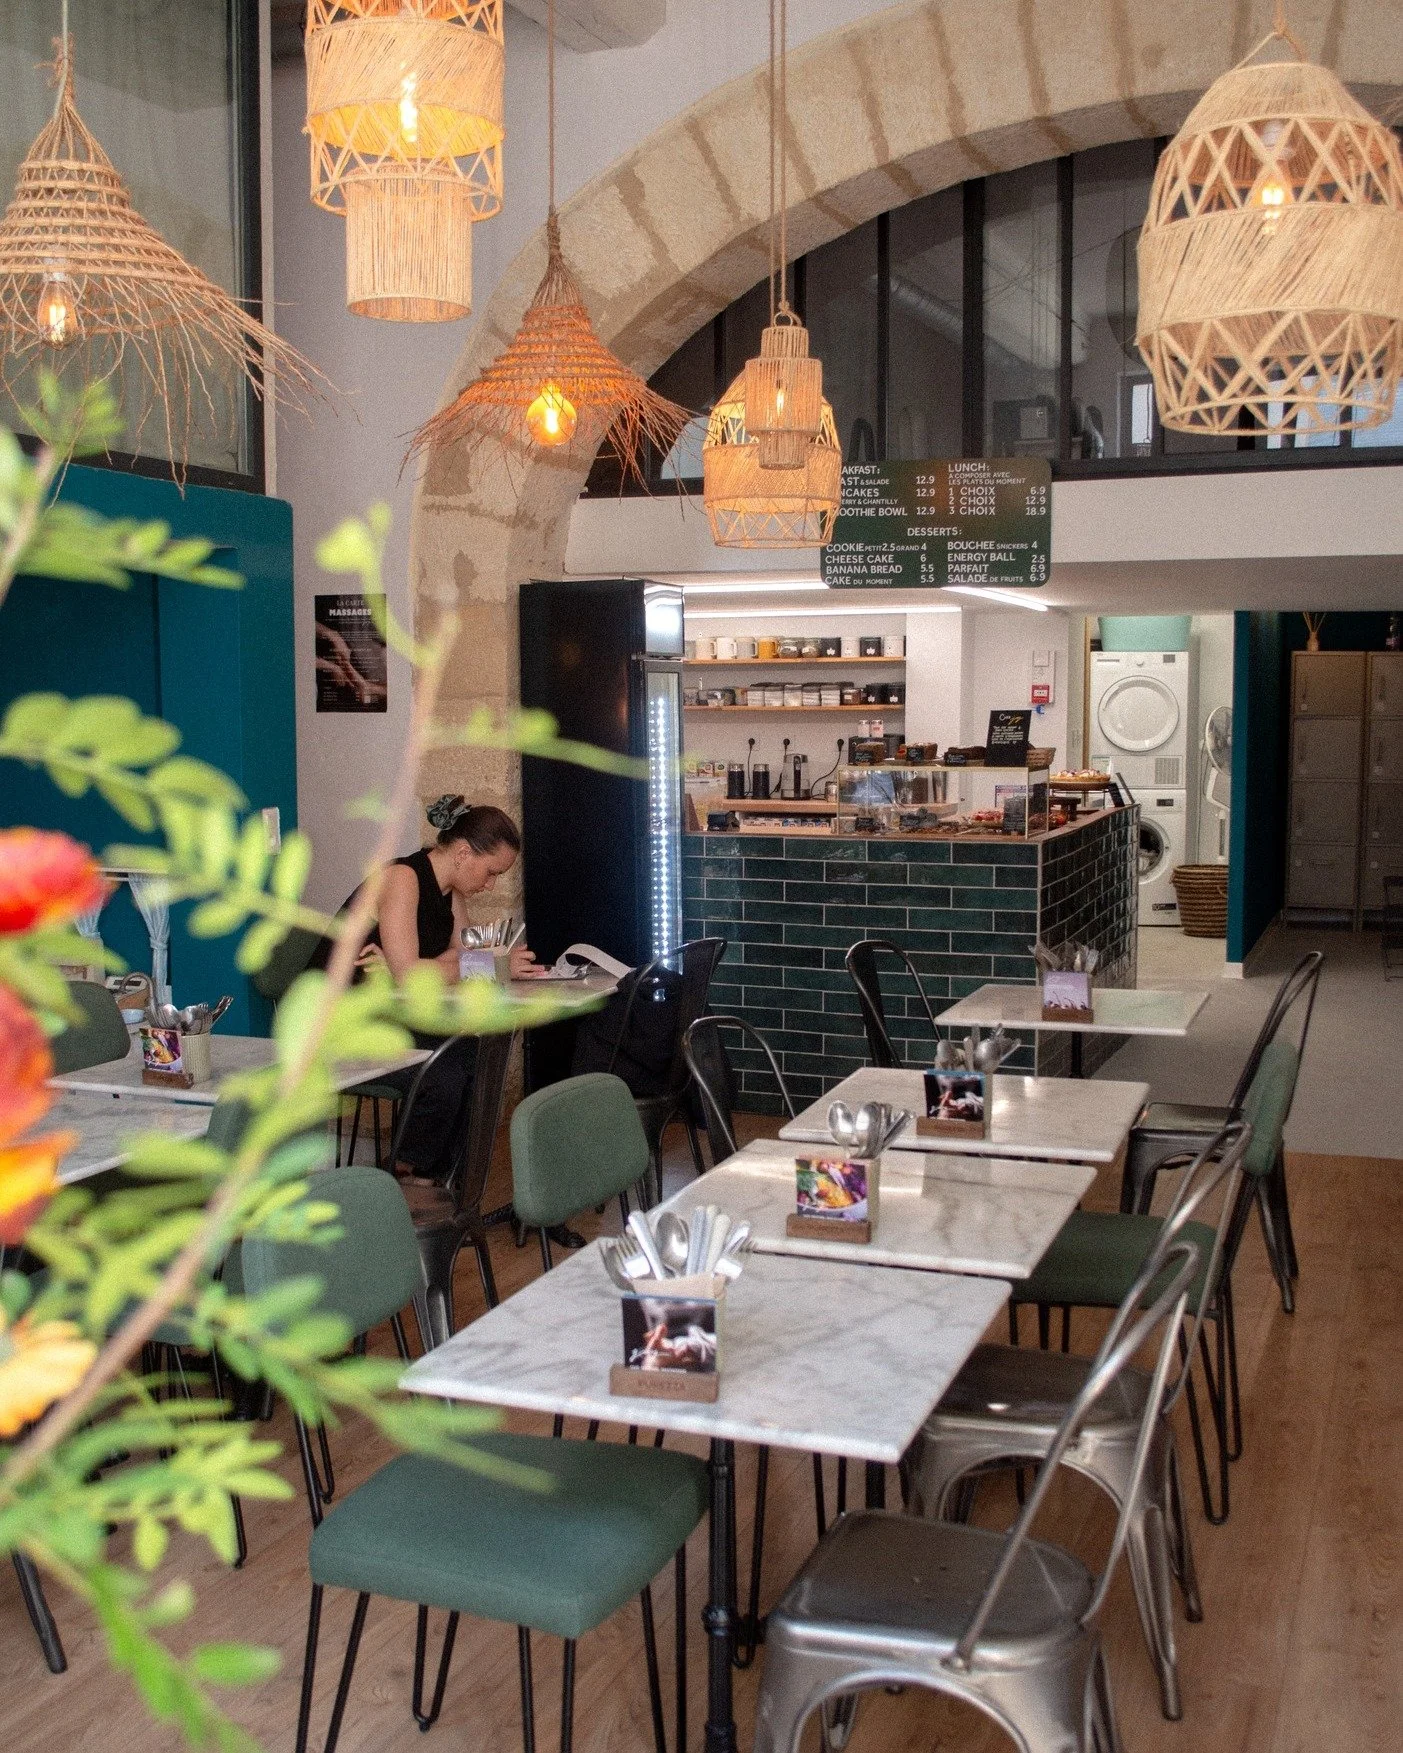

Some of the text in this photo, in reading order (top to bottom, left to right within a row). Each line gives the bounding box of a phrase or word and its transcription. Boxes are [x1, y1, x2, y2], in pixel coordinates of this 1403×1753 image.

[842, 466, 880, 474] AKFAST:
[948, 463, 990, 472] LUNCH:
[841, 477, 859, 485] AST
[916, 476, 935, 484] 12.9
[841, 489, 935, 497] NCAKES 12.9
[960, 487, 995, 495] CHOIX
[1030, 486, 1046, 495] 6.9
[949, 496, 1046, 505] 2 CHOIX 12.9
[839, 507, 935, 516] OOTHIE BOWL 12.9
[949, 506, 1046, 515] 3 CHOIX 18.9
[907, 527, 962, 536] DESSERTS:
[826, 543, 864, 552] COOKIE
[1031, 541, 1037, 549] 4
[825, 554, 926, 564] CHEESE CAKE 6
[948, 553, 1045, 563] ENERGY BALL 2.5
[826, 564, 934, 574] BANANA BREAD 5.5
[948, 564, 1045, 573] PARFAIT 6.9
[825, 577, 851, 585] CAKE
[921, 575, 934, 583] 5.5
[948, 574, 987, 583] SALADE
[1030, 573, 1045, 582] 6.9
